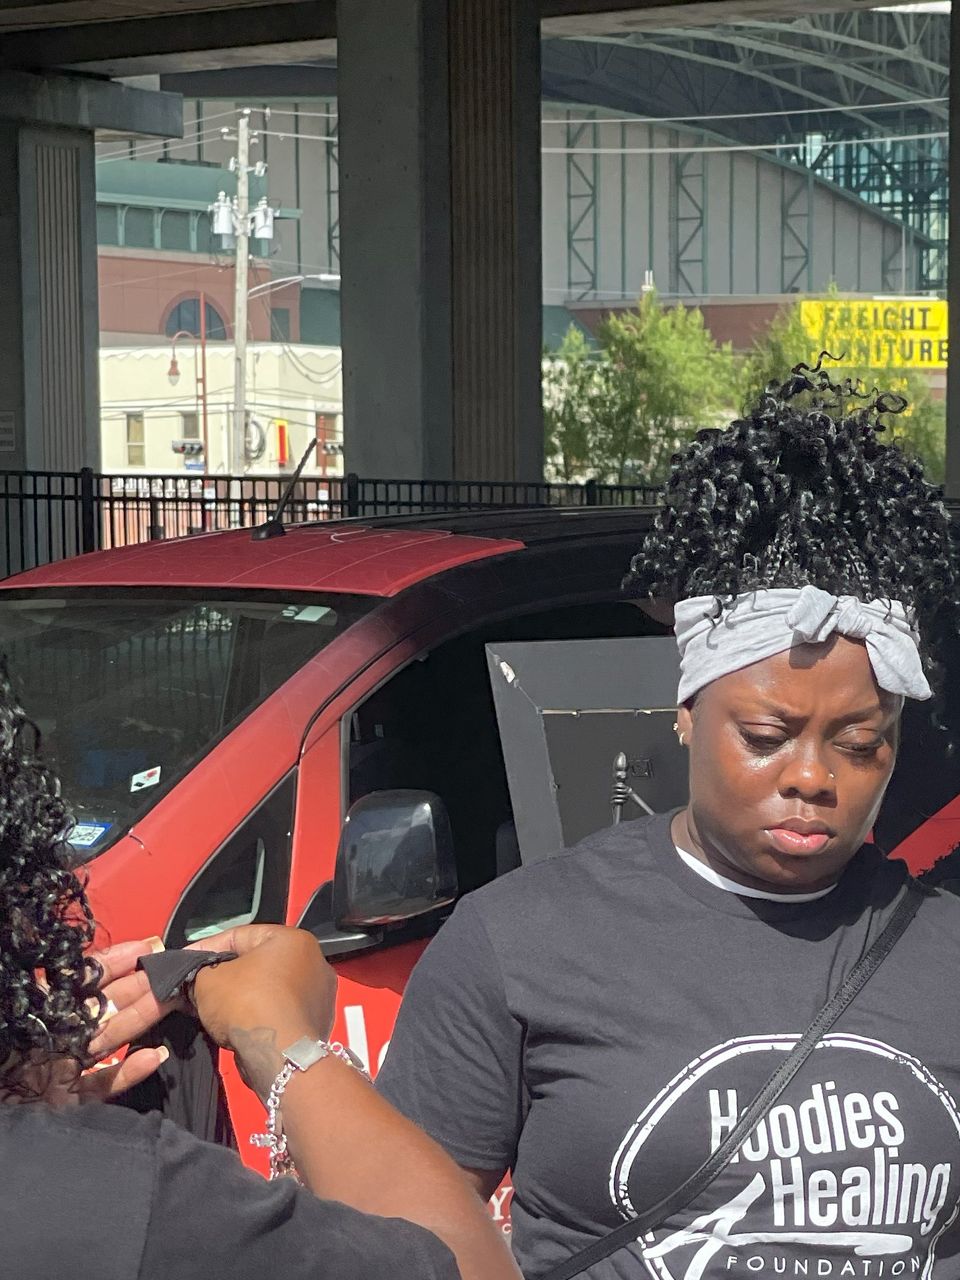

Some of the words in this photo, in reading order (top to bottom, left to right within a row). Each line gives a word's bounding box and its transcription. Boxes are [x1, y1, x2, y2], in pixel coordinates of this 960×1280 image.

[824, 307, 931, 330] FREIGHT
[708, 1080, 905, 1165] Hoodies
[769, 1147, 951, 1234] Healing
[726, 1254, 922, 1278] FOUNDATION
